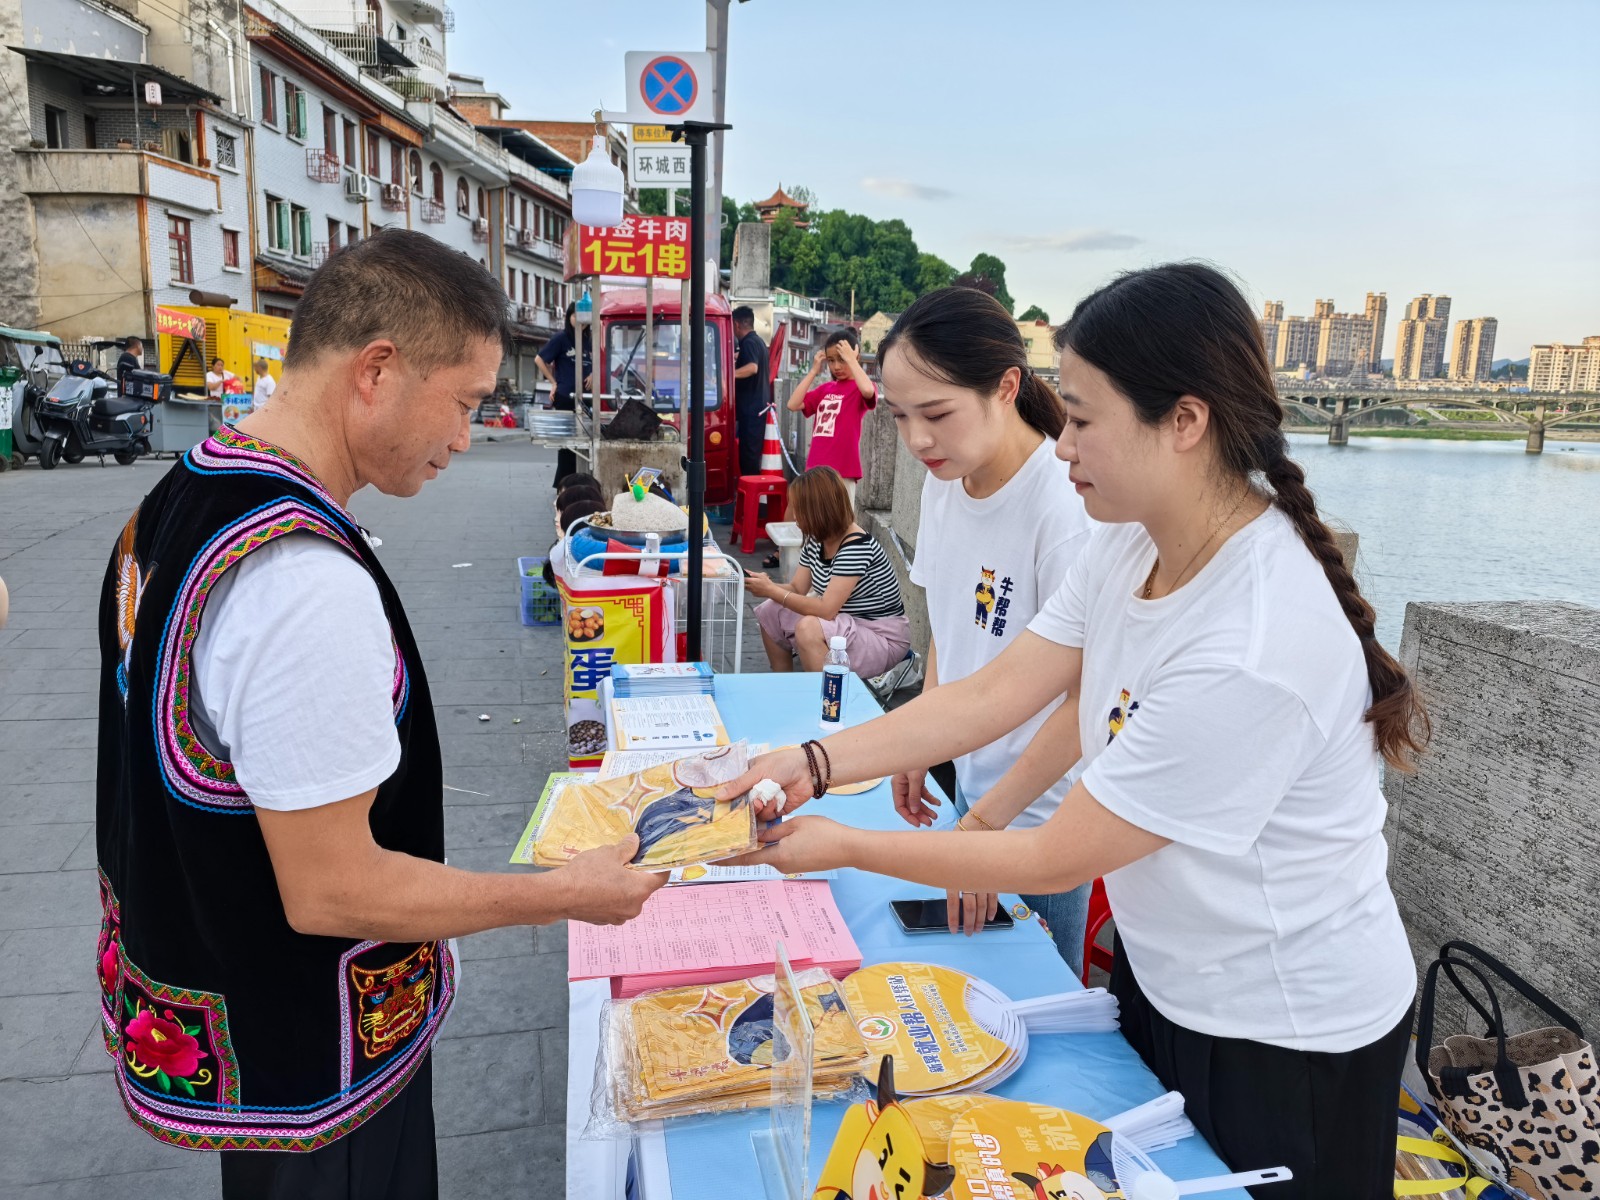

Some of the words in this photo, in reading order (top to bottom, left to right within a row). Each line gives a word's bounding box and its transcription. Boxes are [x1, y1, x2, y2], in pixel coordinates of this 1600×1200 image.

[639, 156, 692, 175] 环城西
[585, 239, 686, 276] 1元1串
[991, 576, 1014, 637] 牛帮帮
[570, 648, 617, 691] 蛋
[1016, 1126, 1042, 1153] 新晃
